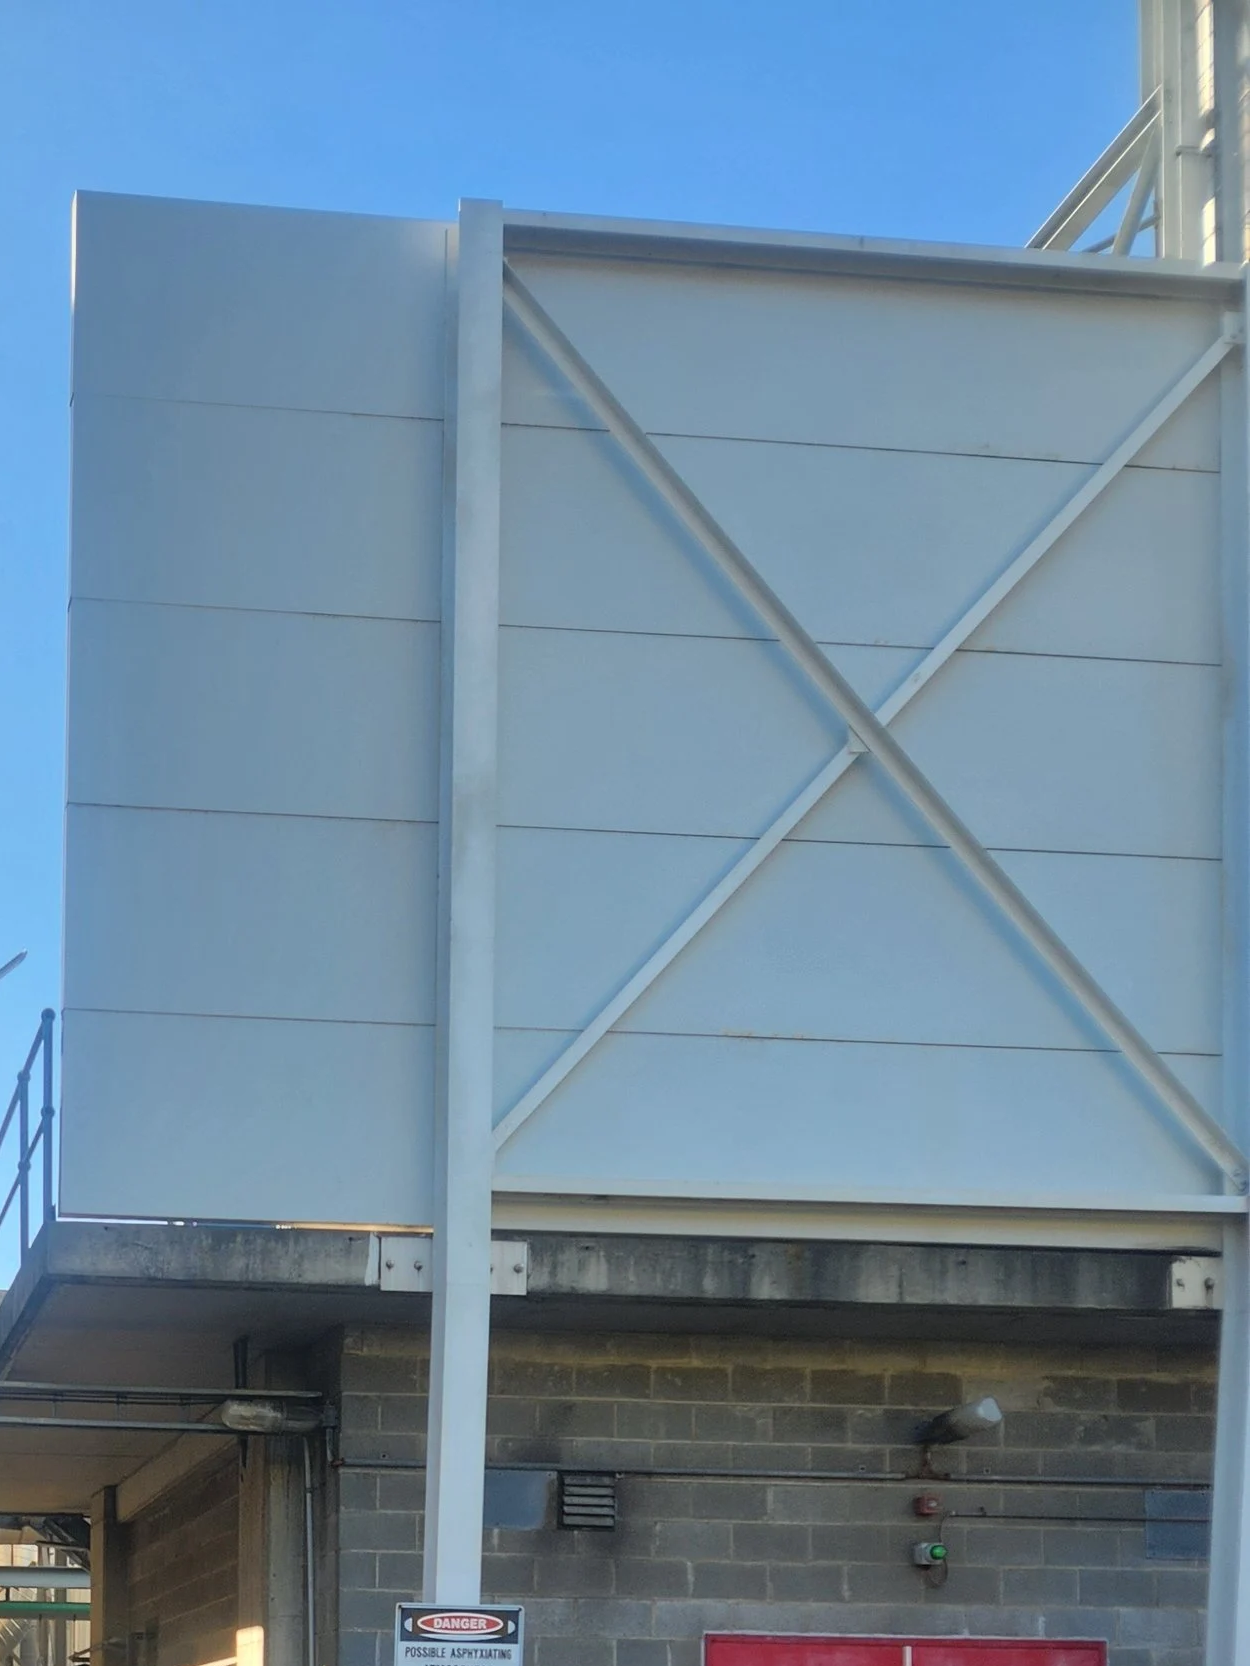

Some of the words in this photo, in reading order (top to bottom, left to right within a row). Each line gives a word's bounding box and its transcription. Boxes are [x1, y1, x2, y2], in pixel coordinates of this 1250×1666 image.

[433, 1617, 487, 1630] DANGER
[405, 1646, 446, 1658] POSSIBLE
[450, 1648, 512, 1660] ASPHYXIATING
